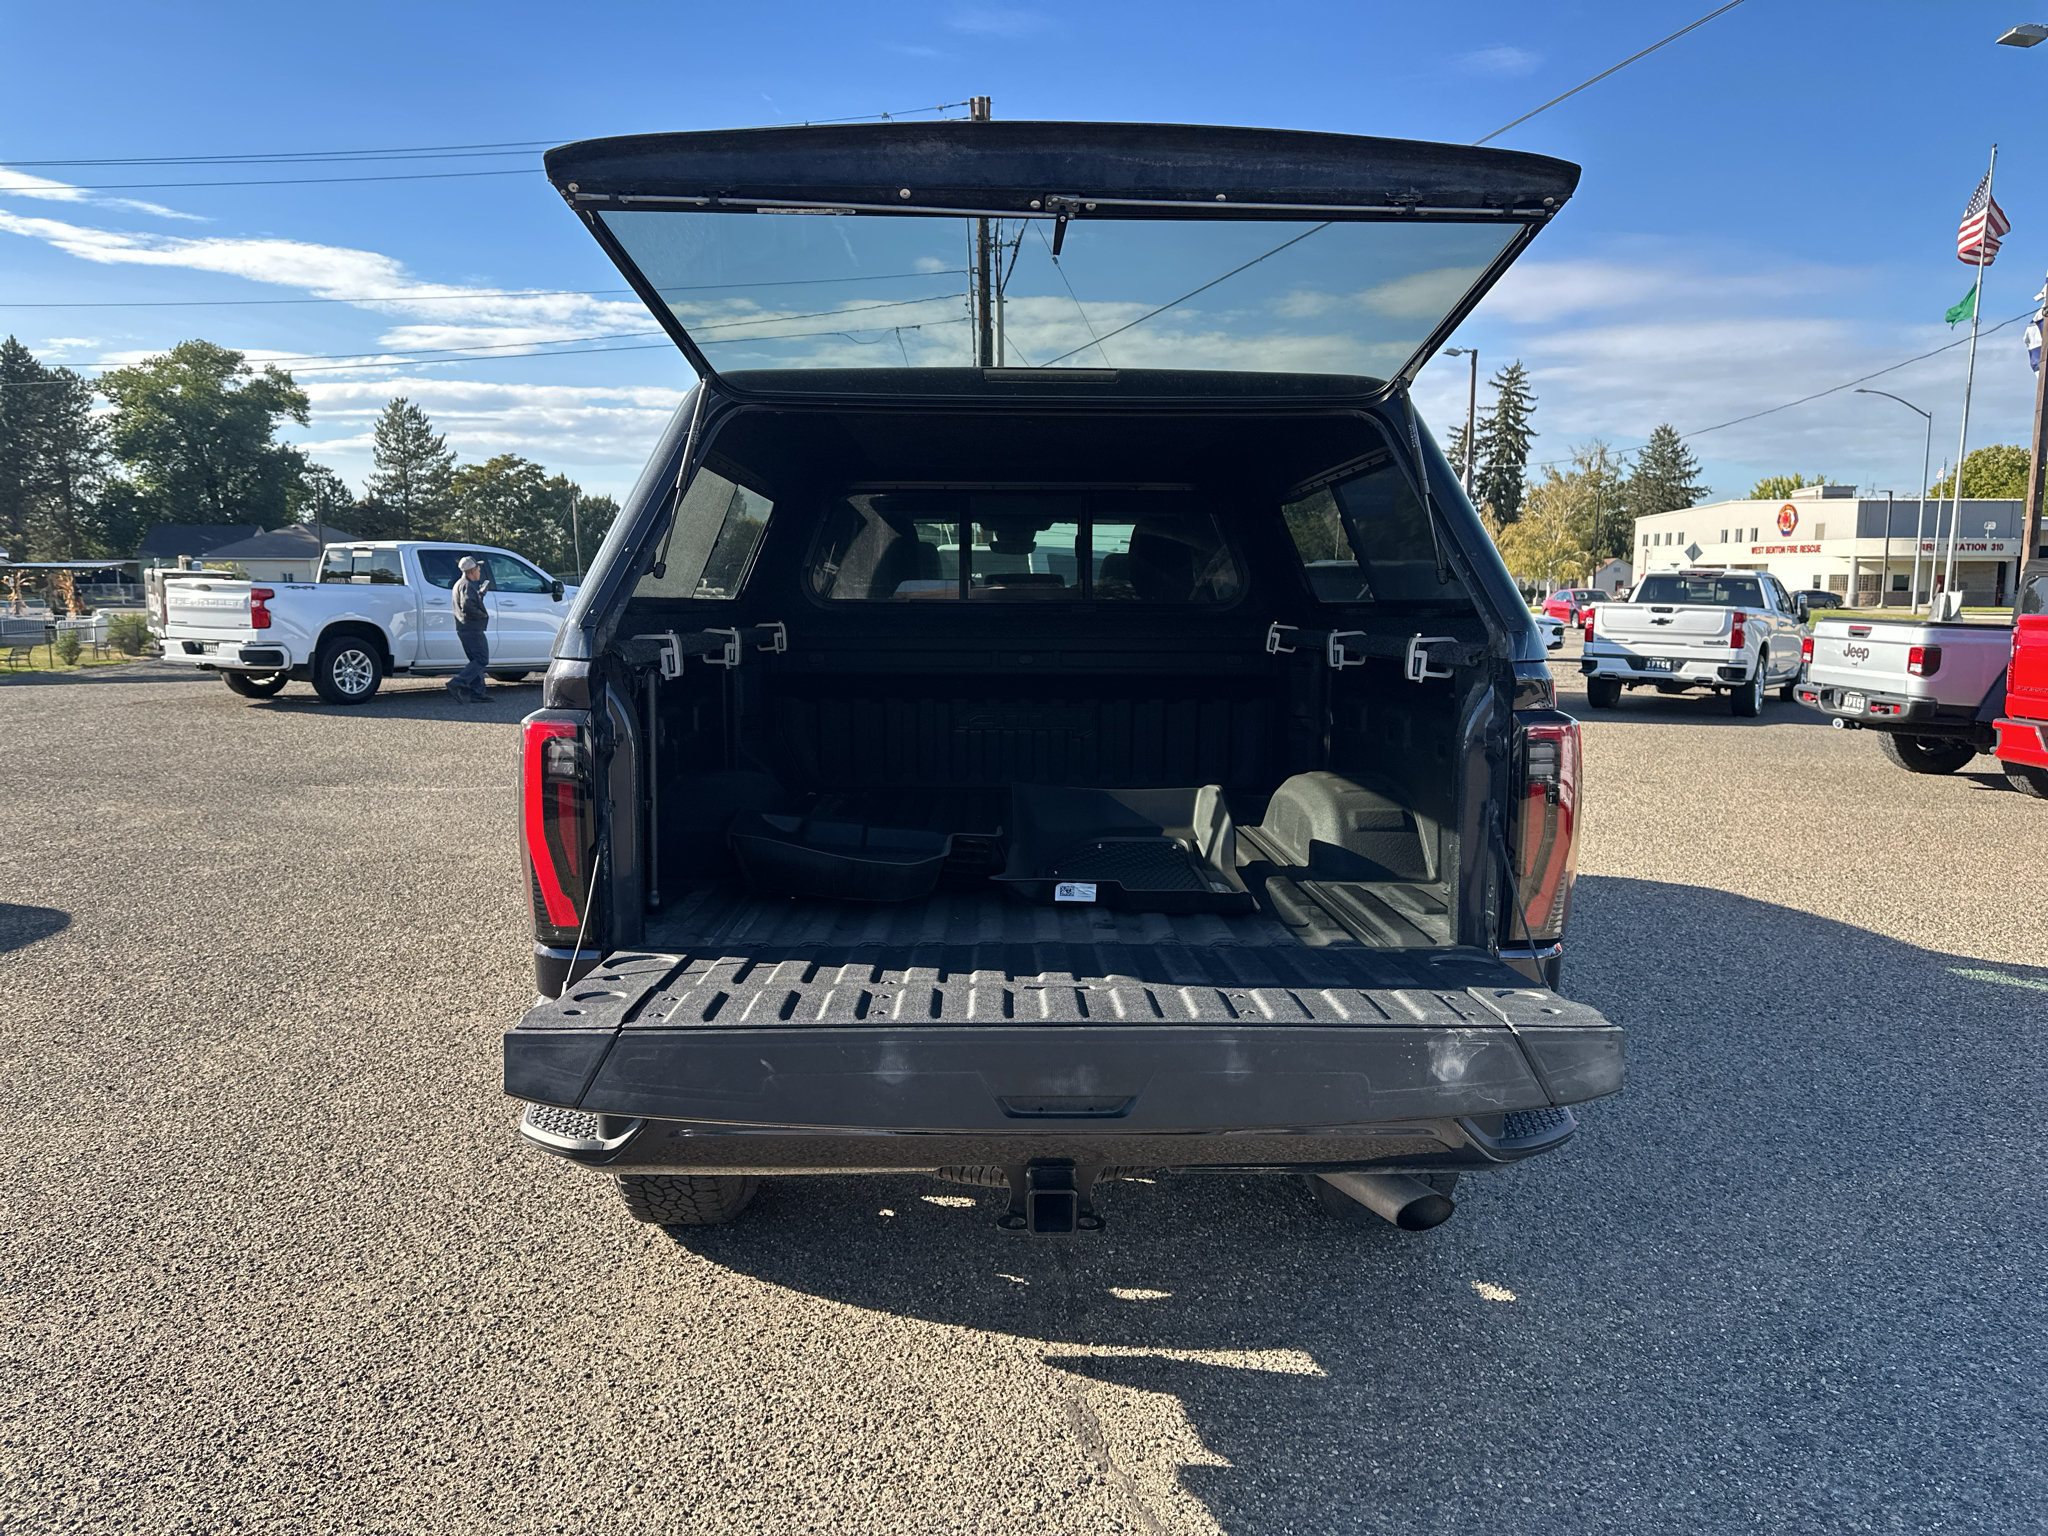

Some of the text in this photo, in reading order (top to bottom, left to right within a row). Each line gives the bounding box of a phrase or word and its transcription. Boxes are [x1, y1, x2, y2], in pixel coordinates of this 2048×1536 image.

[1765, 546, 1785, 554] BENTON
[1787, 545, 1798, 553] FIRE
[1800, 544, 1821, 553] RESCUE
[1990, 543, 2004, 551] 310
[1843, 643, 1869, 661] Jeep
